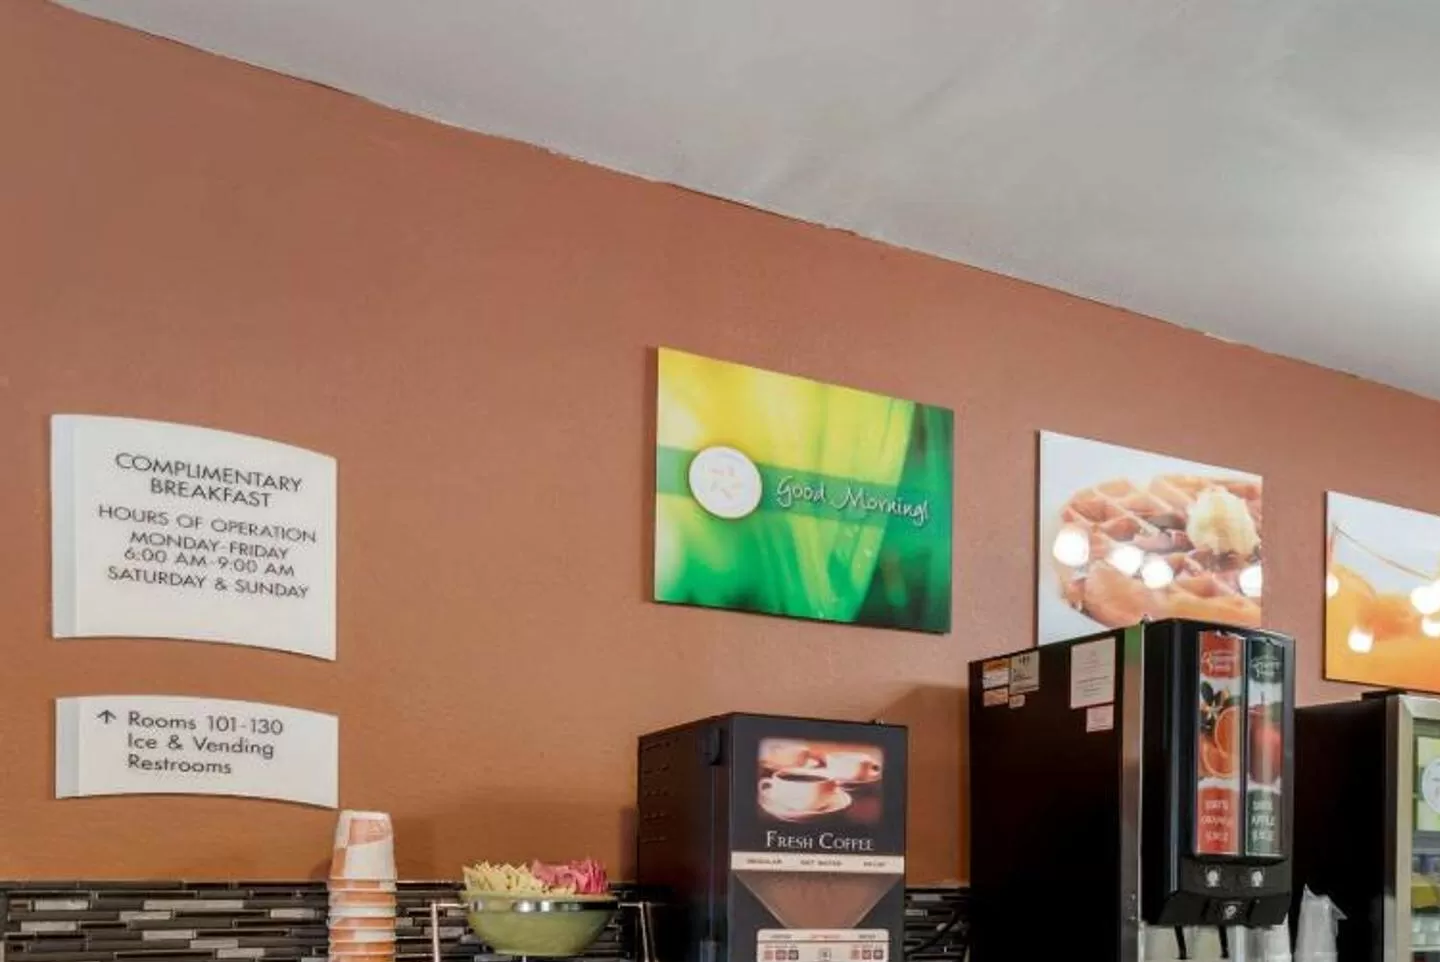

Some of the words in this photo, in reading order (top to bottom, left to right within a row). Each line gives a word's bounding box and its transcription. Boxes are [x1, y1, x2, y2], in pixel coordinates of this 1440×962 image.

[115, 451, 303, 493] COMPLIMENTARY
[150, 477, 273, 508] BREAKFAST
[776, 475, 826, 508] Good
[98, 504, 170, 526] HOURS
[176, 513, 204, 530] OF
[211, 517, 317, 544] OPERATION
[124, 547, 168, 564] 6:00
[264, 563, 295, 578] AM
[107, 566, 206, 589] SATURDAY
[214, 576, 228, 591] &
[235, 578, 309, 599] SUNDAY
[128, 710, 197, 731] Rooms
[128, 733, 157, 750] Ice
[168, 735, 184, 751] &
[193, 735, 275, 760] Vending
[128, 753, 233, 775] Restrooms
[766, 830, 813, 849] FRESH
